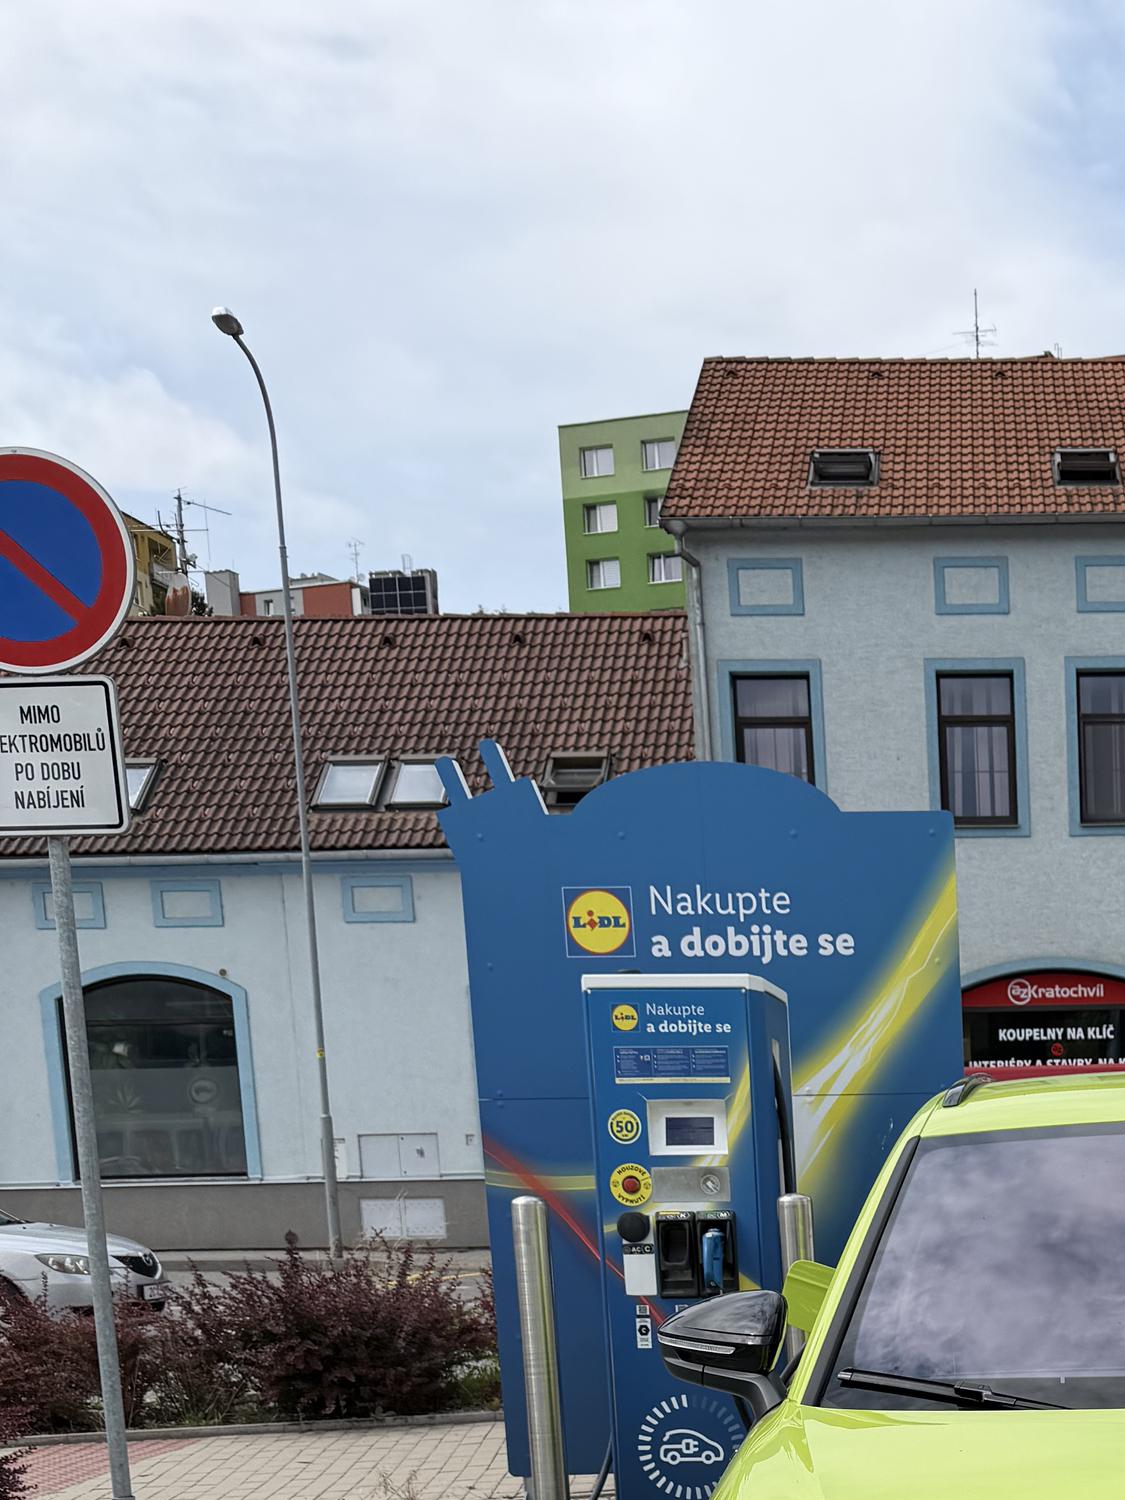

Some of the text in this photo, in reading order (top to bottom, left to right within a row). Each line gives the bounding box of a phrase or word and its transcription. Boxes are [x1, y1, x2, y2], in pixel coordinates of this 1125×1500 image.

[19, 704, 61, 724] MIMO
[0, 727, 106, 753] EKTROMOBILŮ
[14, 761, 81, 781] PO DOBU
[14, 785, 85, 809] NABÍJENÍ
[649, 884, 791, 922] Nakupte
[651, 925, 855, 965] a dobijte se
[1029, 983, 1104, 998] Kratochvíl
[646, 1002, 705, 1018] Nakupte
[646, 1020, 731, 1035] a dobijte se
[998, 1024, 1115, 1042] KOUPELNY NA KLÍČ
[615, 1120, 634, 1133] 50
